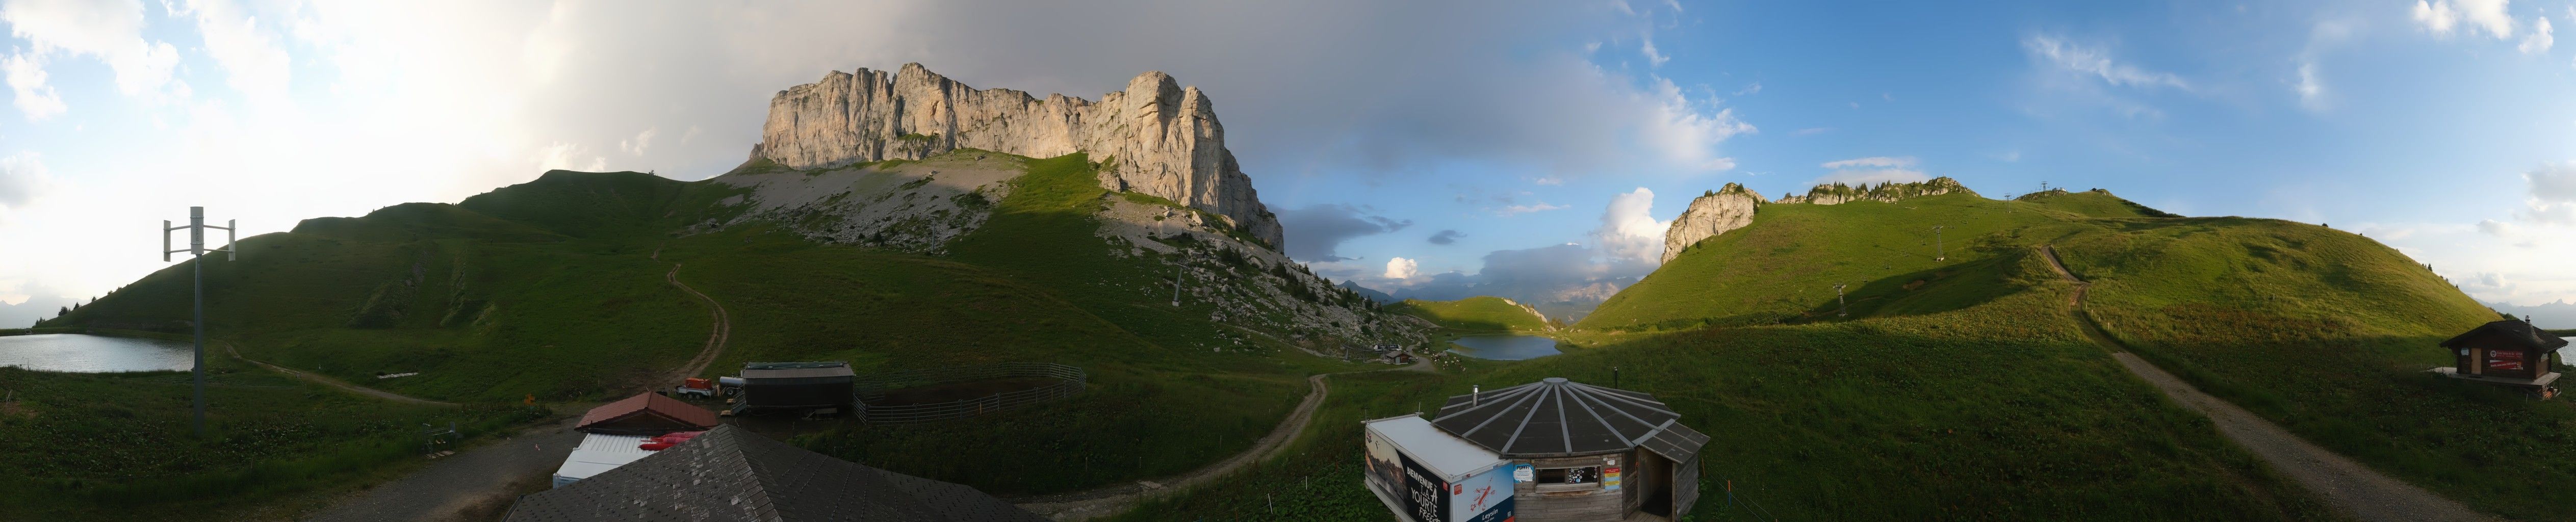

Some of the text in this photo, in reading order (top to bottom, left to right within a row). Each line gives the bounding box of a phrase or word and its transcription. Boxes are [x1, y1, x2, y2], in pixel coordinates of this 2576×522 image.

[1407, 466, 1433, 492] BIENVENUE
[1411, 487, 1437, 517] YOURTE
[1420, 485, 1430, 500] LA
[1482, 509, 1498, 520] Leysin
